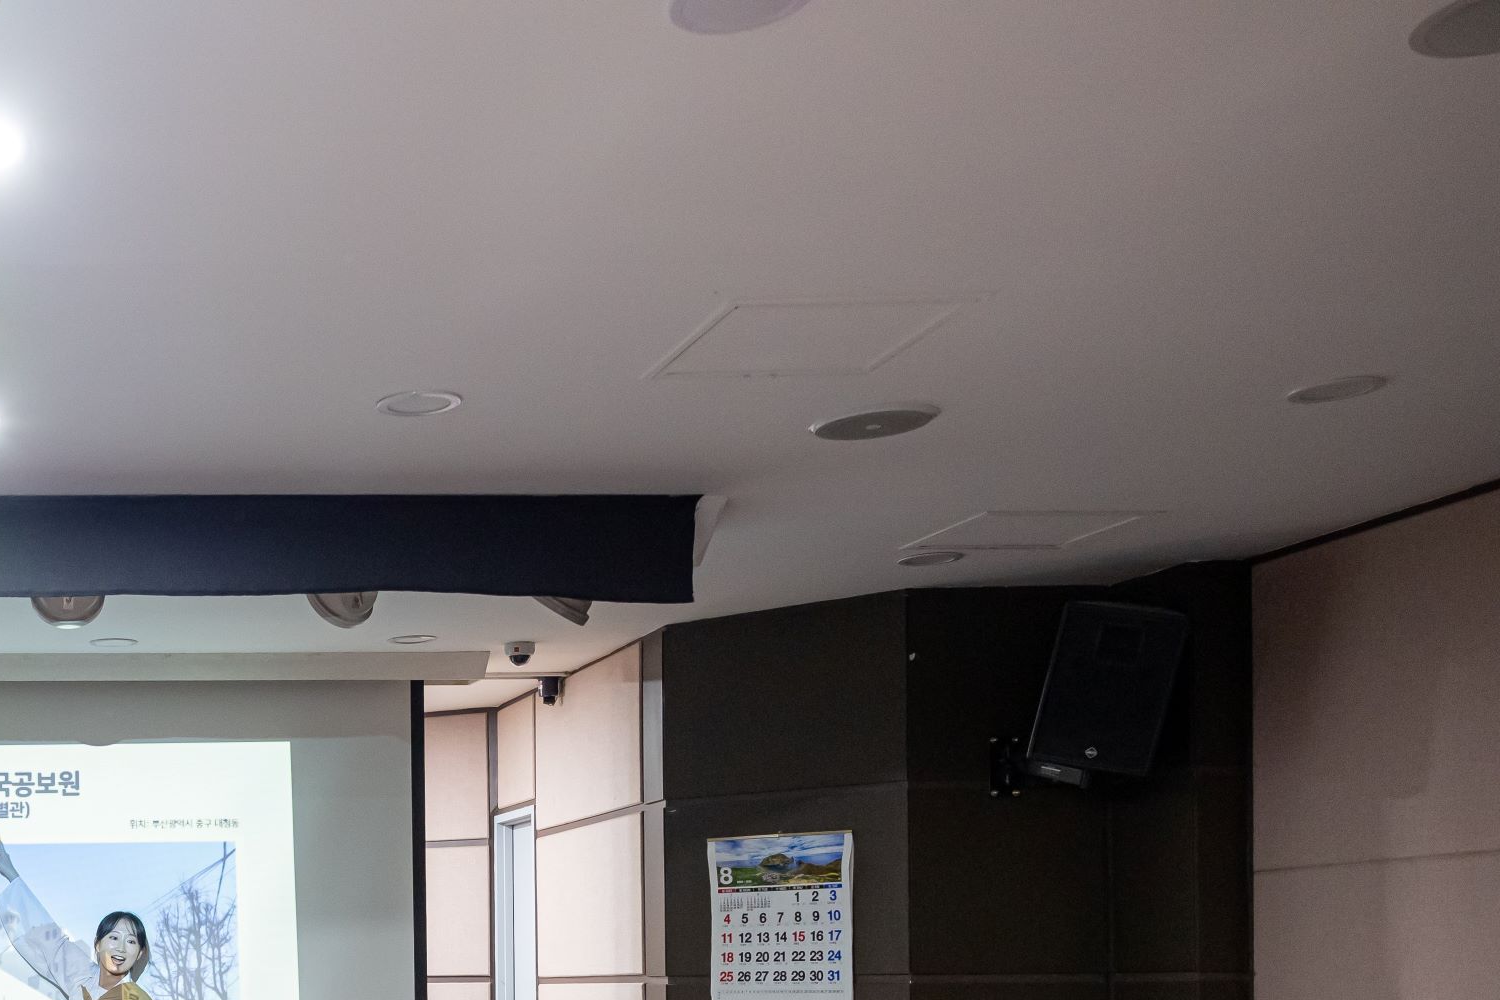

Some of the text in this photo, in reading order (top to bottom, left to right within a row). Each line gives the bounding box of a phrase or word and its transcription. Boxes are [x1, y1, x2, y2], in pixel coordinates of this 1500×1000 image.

[720, 867, 733, 884] 8
[794, 889, 837, 903] 1 2 3
[723, 909, 841, 925] 4 5 6 7 8 9 10
[721, 929, 842, 944] 11 12 13 14 15 16 17
[721, 949, 842, 963] 18 19 20 21 22 23 24
[719, 969, 840, 983] 25 26 27 28 29 30 31
